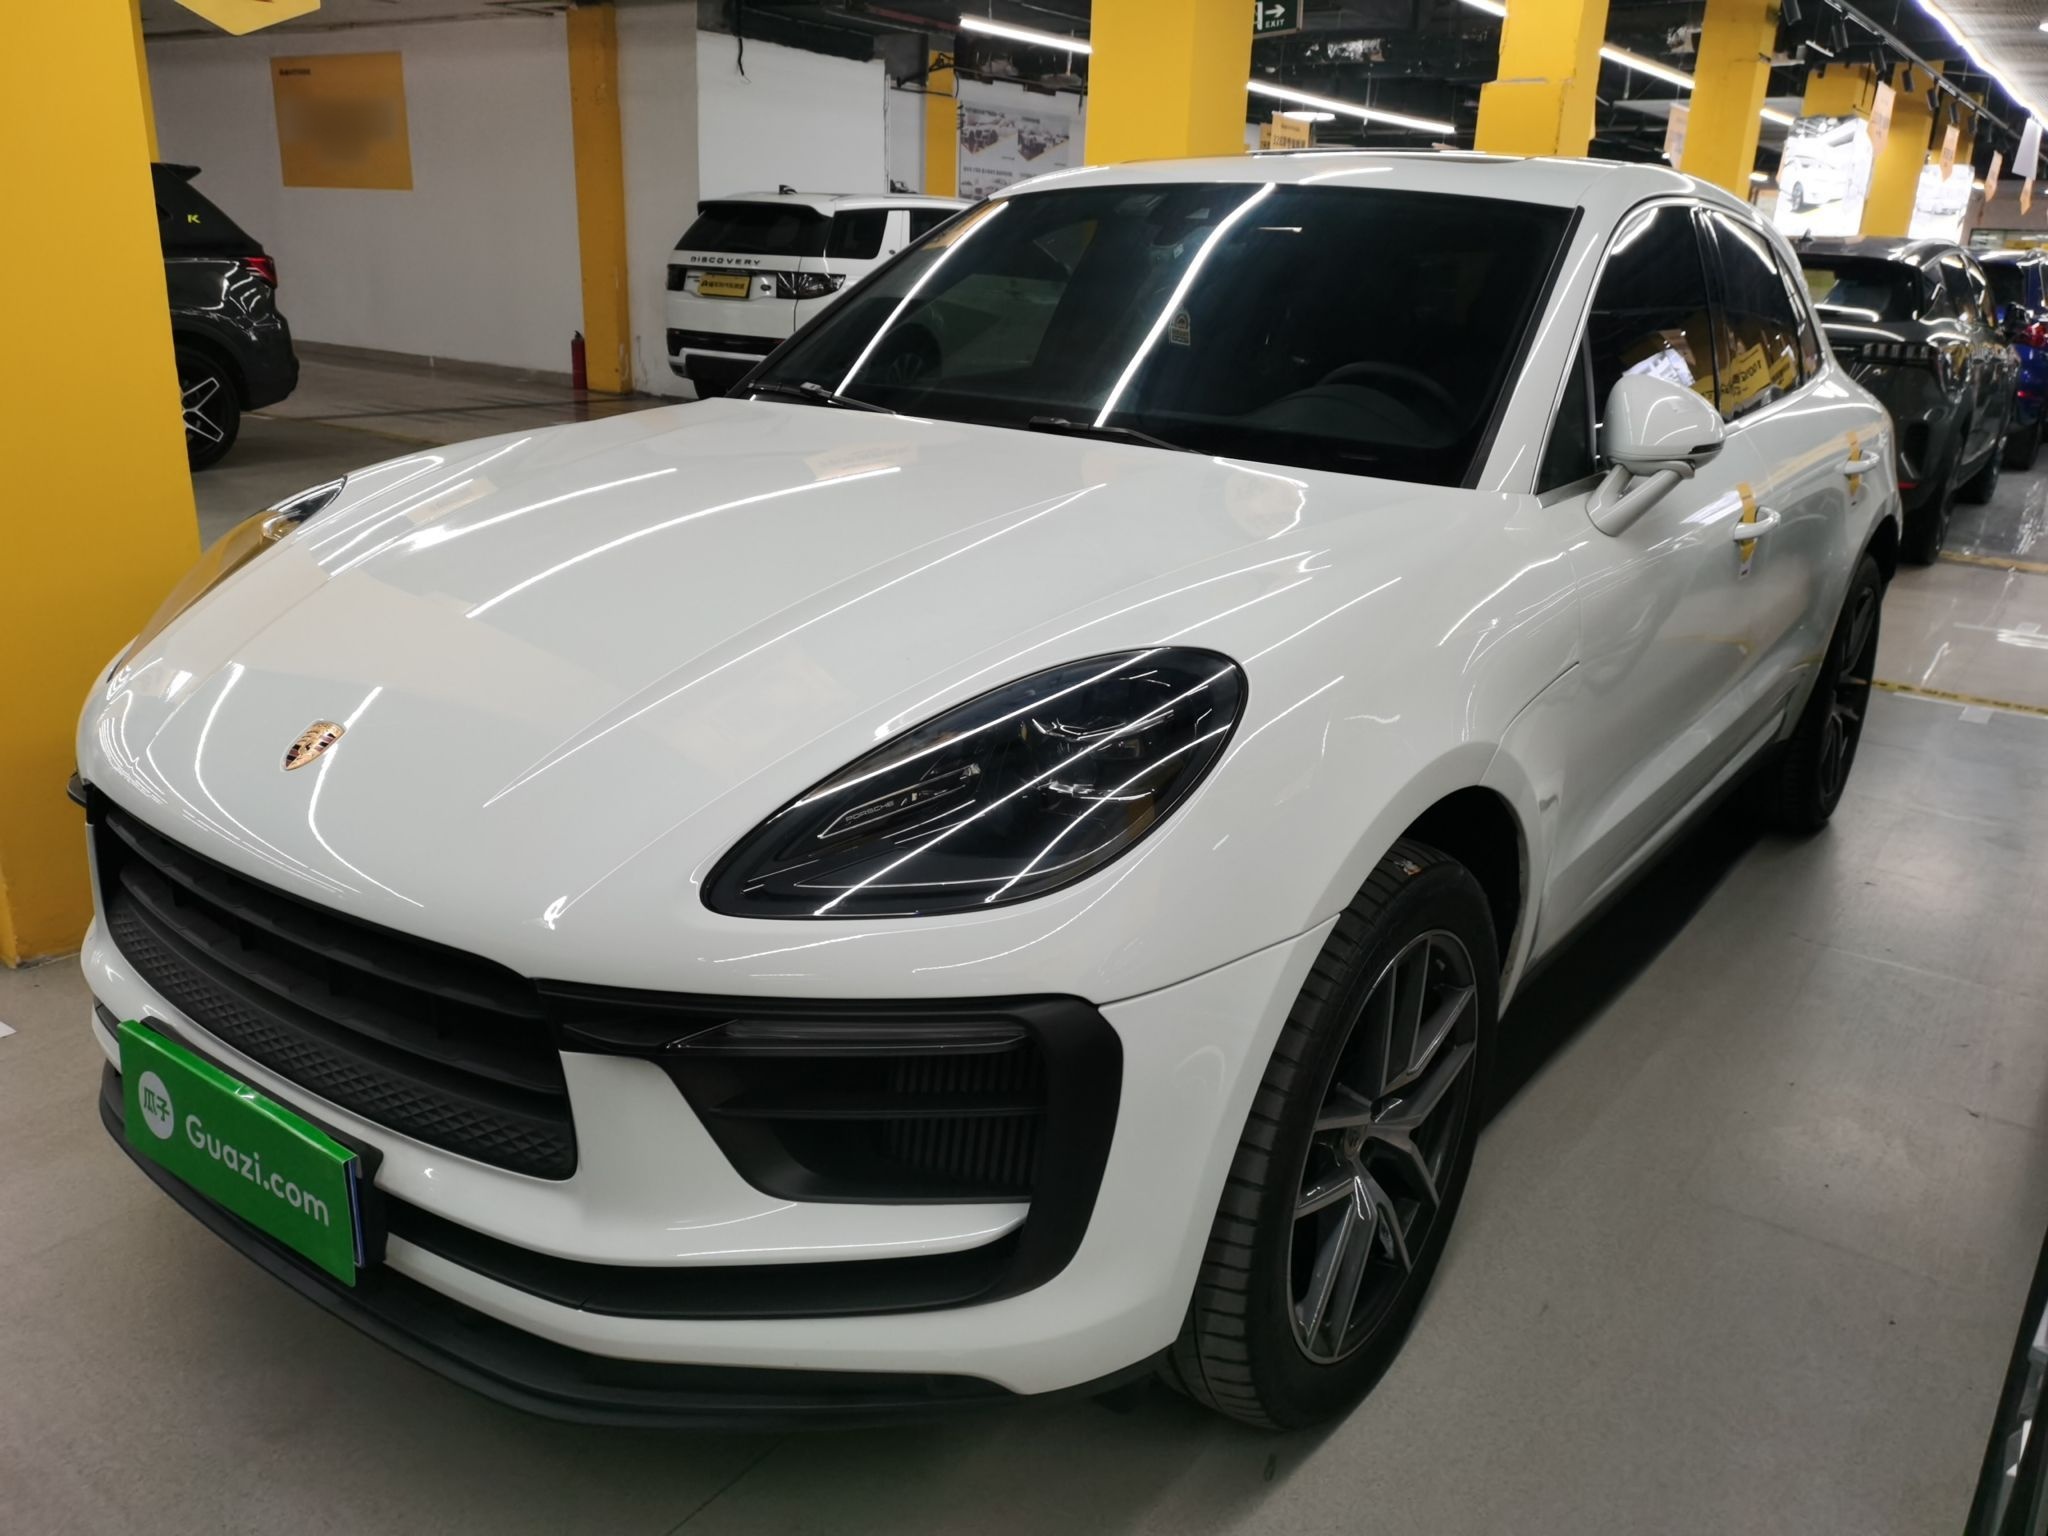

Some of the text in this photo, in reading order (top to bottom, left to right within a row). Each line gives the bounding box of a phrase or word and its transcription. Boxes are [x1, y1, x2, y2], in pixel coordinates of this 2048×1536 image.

[1265, 19, 1285, 28] EXIT
[691, 256, 760, 265] DISCOVERY
[846, 801, 894, 821] PORSCHE
[144, 1087, 170, 1121] 瓜子
[186, 1115, 330, 1227] Guazi.com
